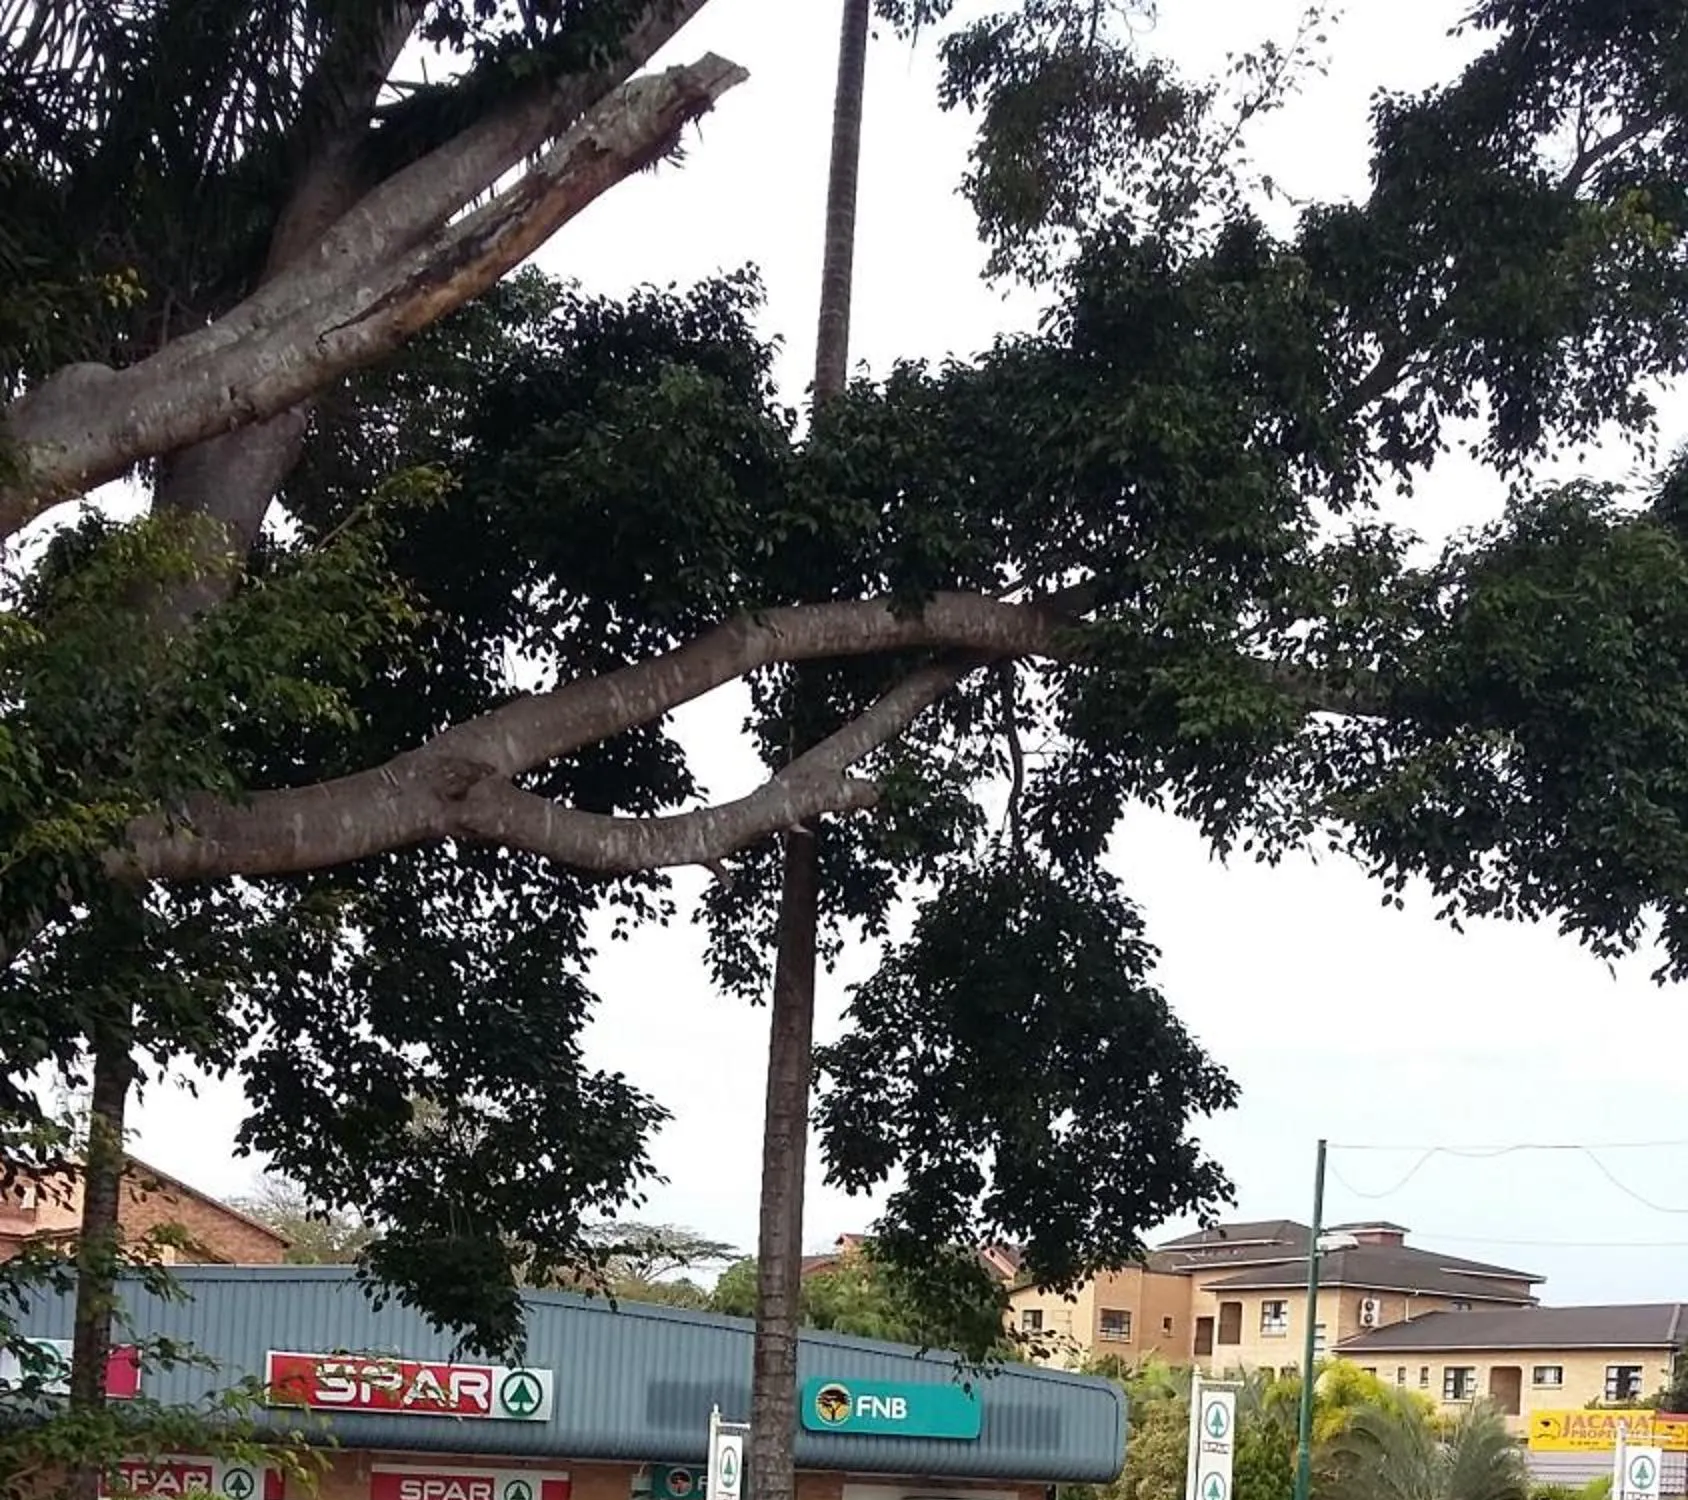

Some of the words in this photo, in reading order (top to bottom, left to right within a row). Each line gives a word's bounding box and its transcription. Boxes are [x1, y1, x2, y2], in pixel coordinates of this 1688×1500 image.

[315, 1362, 490, 1410] SPAR
[855, 1395, 908, 1419] FNB
[1562, 1414, 1650, 1438] JACANA
